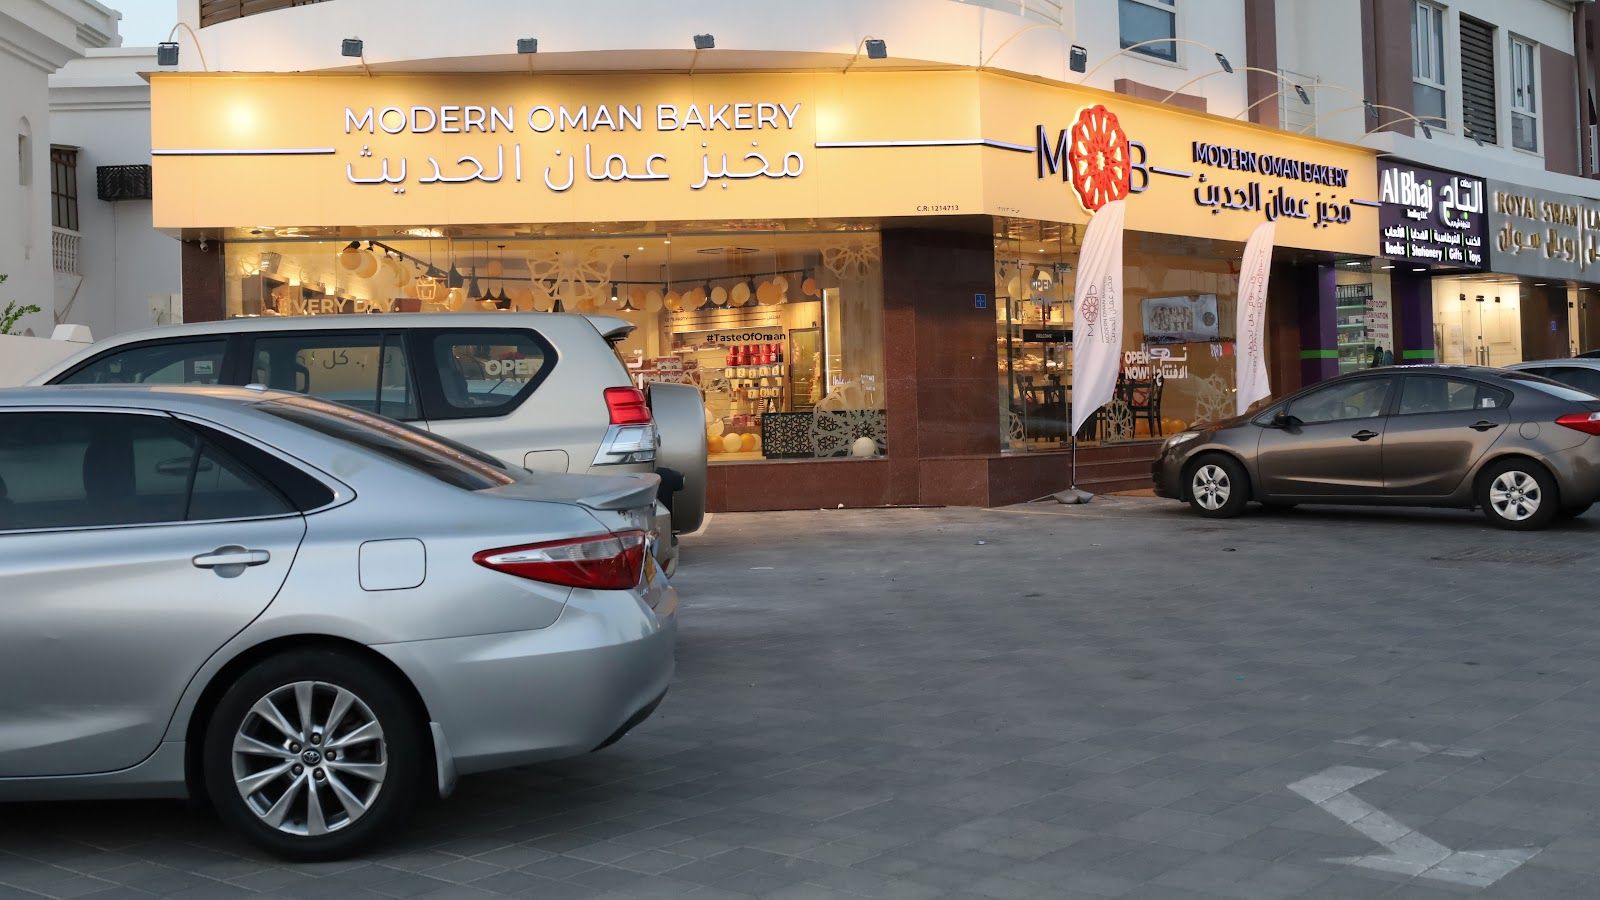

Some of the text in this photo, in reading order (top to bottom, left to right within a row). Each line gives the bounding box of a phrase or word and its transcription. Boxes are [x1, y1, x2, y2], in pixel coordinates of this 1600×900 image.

[345, 102, 802, 134] MODERN OMAN BAKERY
[346, 140, 805, 193] مخبز عمان الحديث
[1192, 141, 1349, 188] MODERN OMAN BAKERY
[1194, 173, 1352, 228] مخبز عمان الحديث
[1381, 168, 1433, 213] Al Bhaj
[931, 204, 959, 212] 1214713
[1496, 191, 1537, 220] ROYAL
[1542, 200, 1578, 227] SWAN
[1385, 241, 1481, 265] Books Stationery Gifts Toys
[706, 332, 786, 342] #TasteOfOman
[1124, 351, 1149, 364] OPEN
[1125, 366, 1149, 379] NOW!
